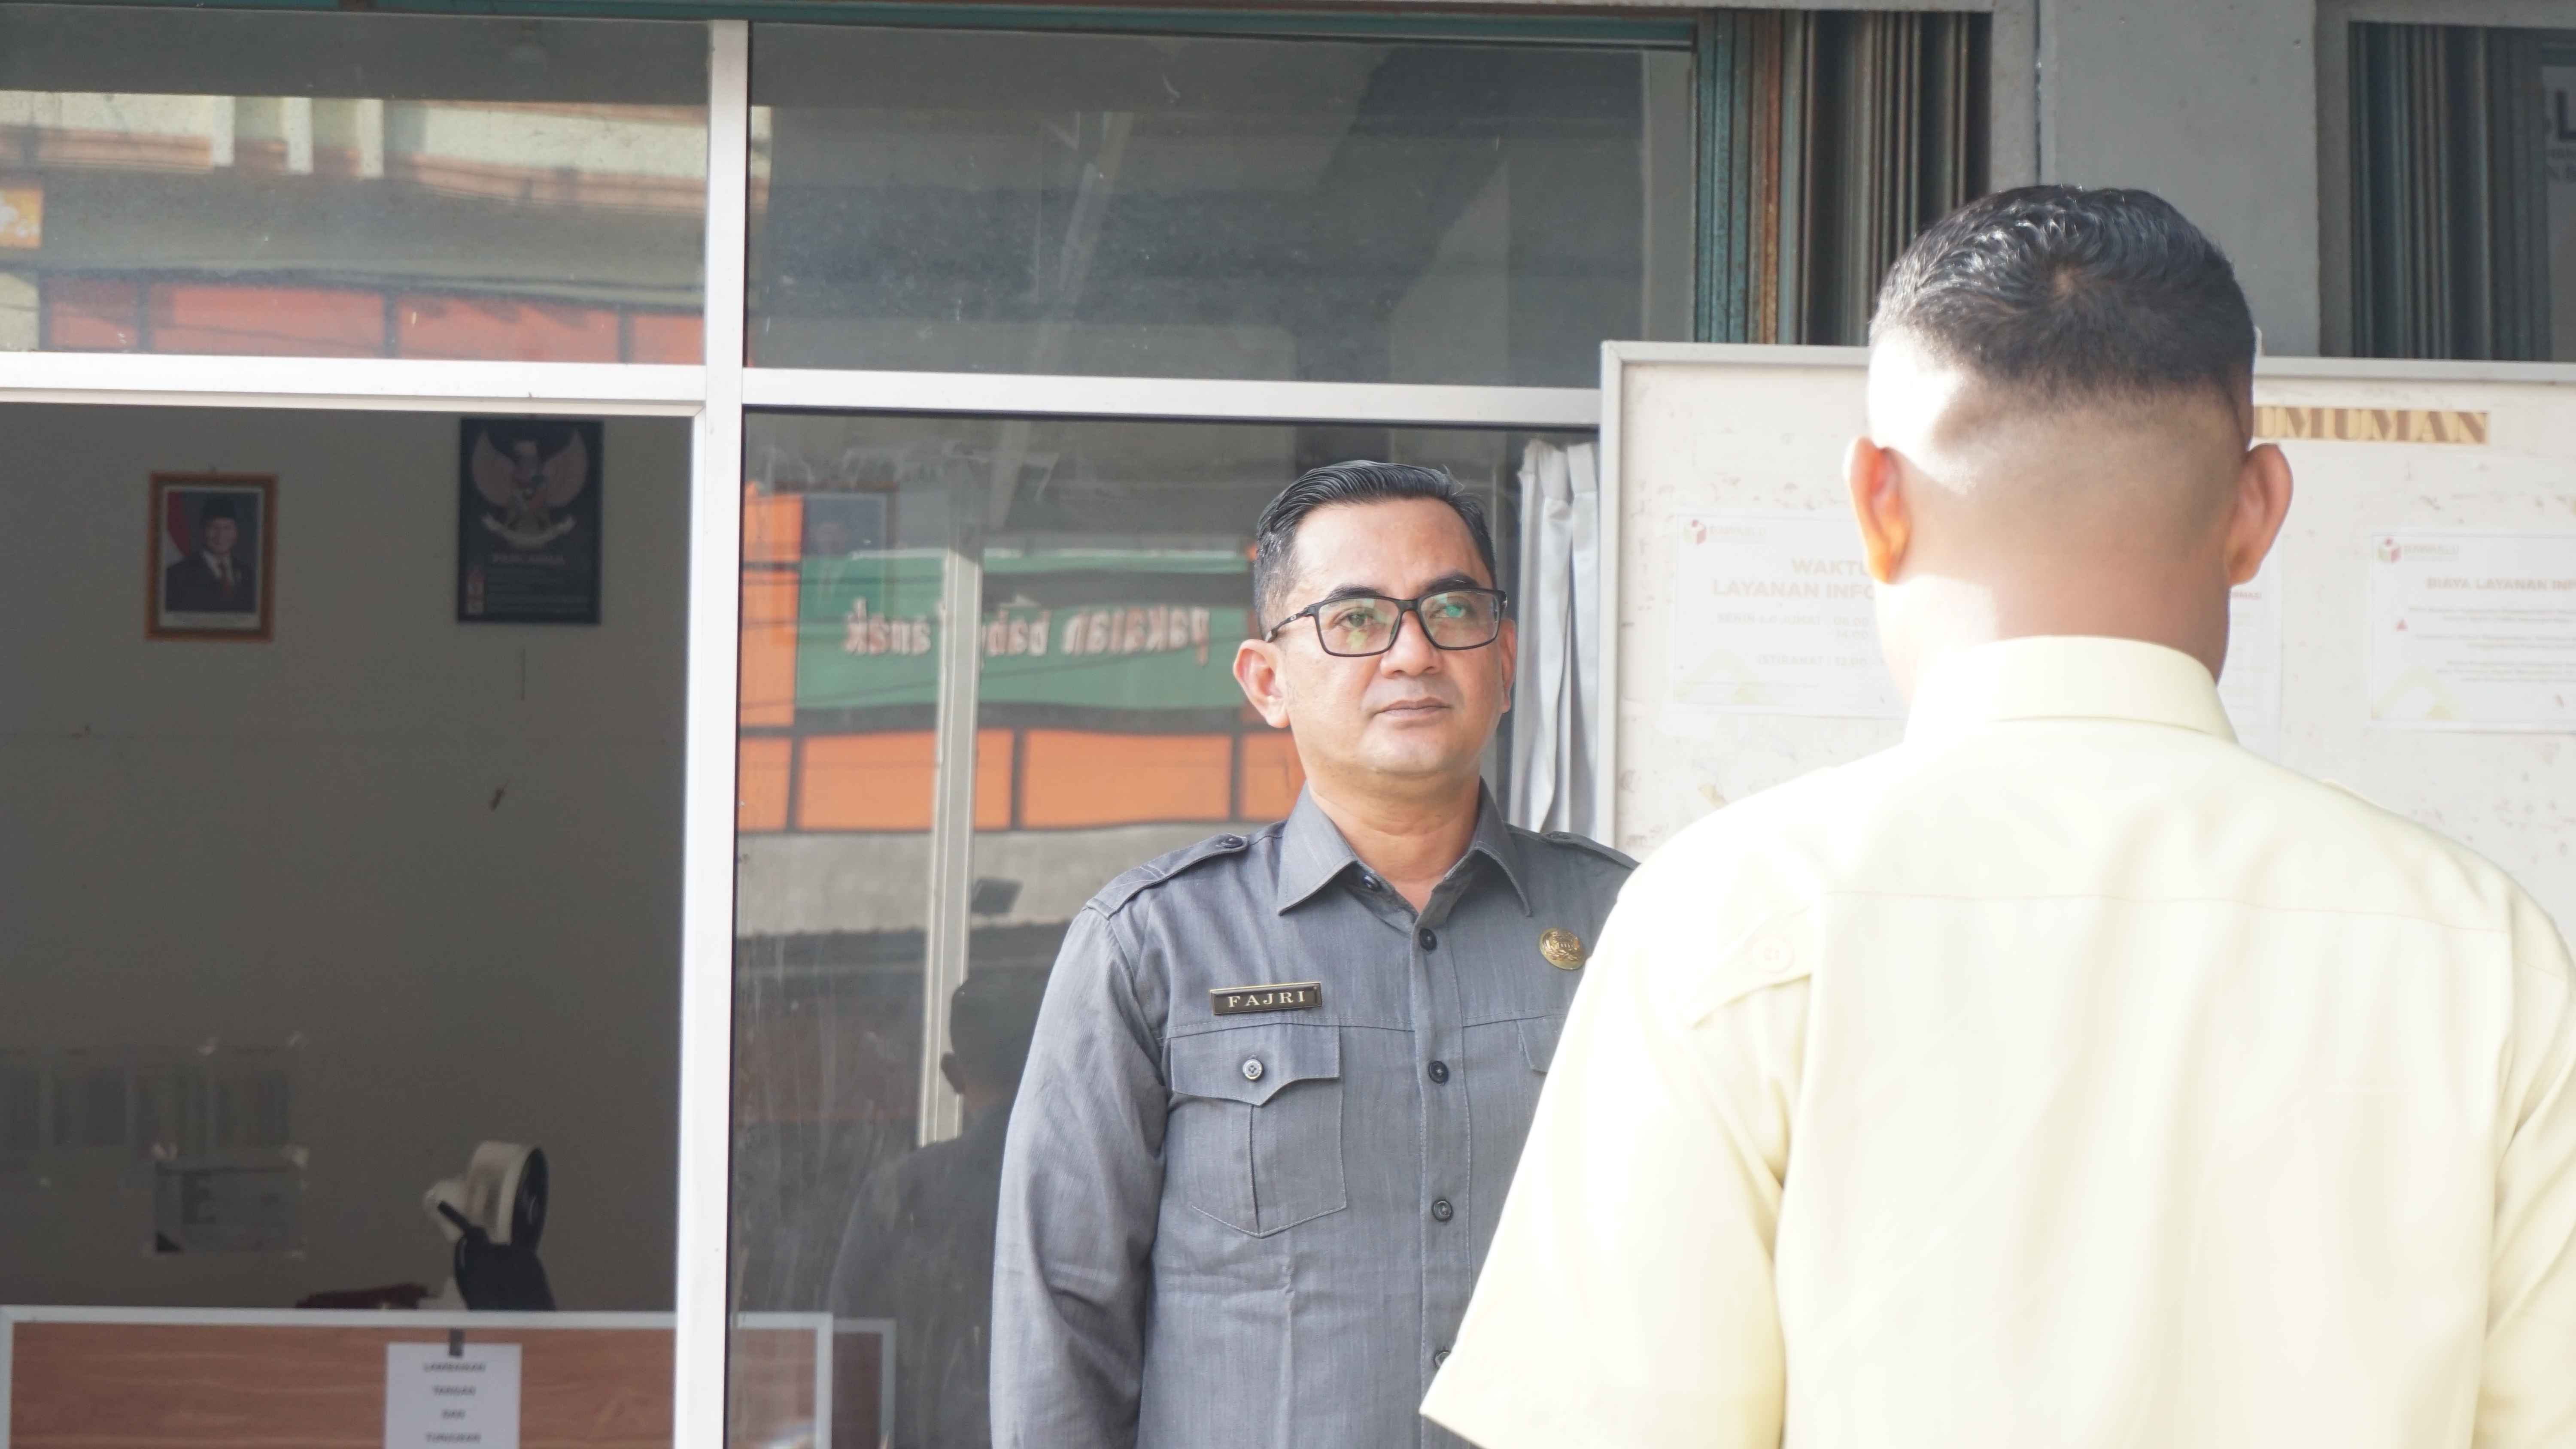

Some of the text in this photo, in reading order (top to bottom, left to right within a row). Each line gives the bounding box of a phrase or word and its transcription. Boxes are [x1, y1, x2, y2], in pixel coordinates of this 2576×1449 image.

[1712, 580, 1819, 598] LAYANAN
[2426, 577, 2471, 589] BIAYA
[2475, 577, 2547, 591] LAYANAN
[1228, 990, 1306, 1008] FAJRI
